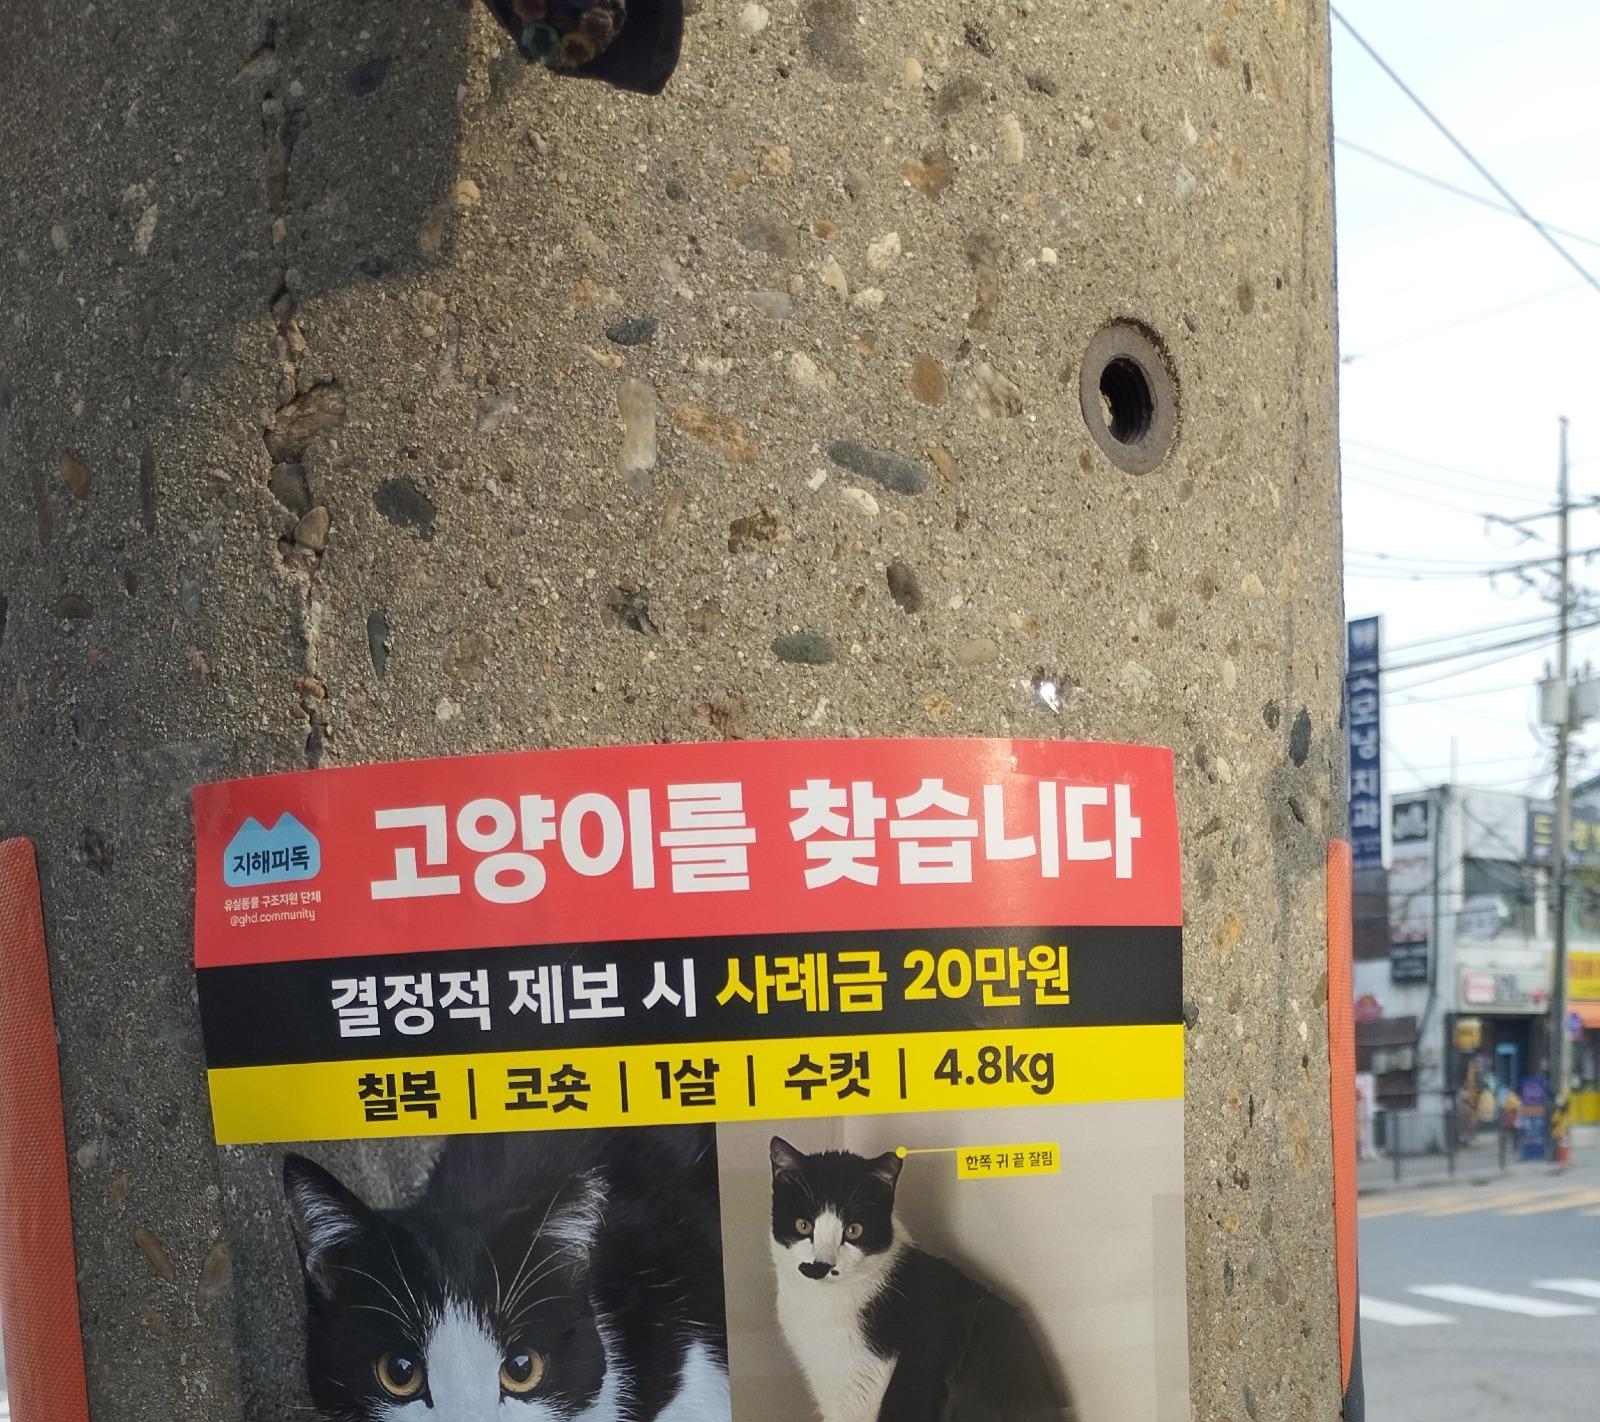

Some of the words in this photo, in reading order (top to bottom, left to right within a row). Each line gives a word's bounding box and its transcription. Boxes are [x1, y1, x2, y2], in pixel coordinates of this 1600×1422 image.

[371, 782, 756, 904] 고양이를
[789, 778, 1141, 889] 찾습니다
[233, 845, 310, 876] 지해피독
[224, 896, 260, 912] 유실동물
[262, 892, 298, 907] 구조지원
[301, 890, 321, 904] 단체
[230, 908, 315, 927] @ghd.community
[330, 969, 491, 1038] 결정적
[508, 962, 625, 1024] 제보
[642, 958, 697, 1018] 시
[715, 950, 888, 1014] 사례금
[903, 945, 1070, 1007] 20만원
[357, 1070, 442, 1123] 칠복
[504, 1063, 591, 1115] 코숏
[655, 1058, 719, 1107] 1살
[784, 1051, 871, 1101] 수컷
[934, 1045, 1055, 1096] 4.8kg
[965, 1154, 992, 1171] 한쪽
[996, 1154, 1008, 1168] 귀
[1012, 1152, 1024, 1168] 끝
[1029, 1150, 1053, 1167] 잘림
